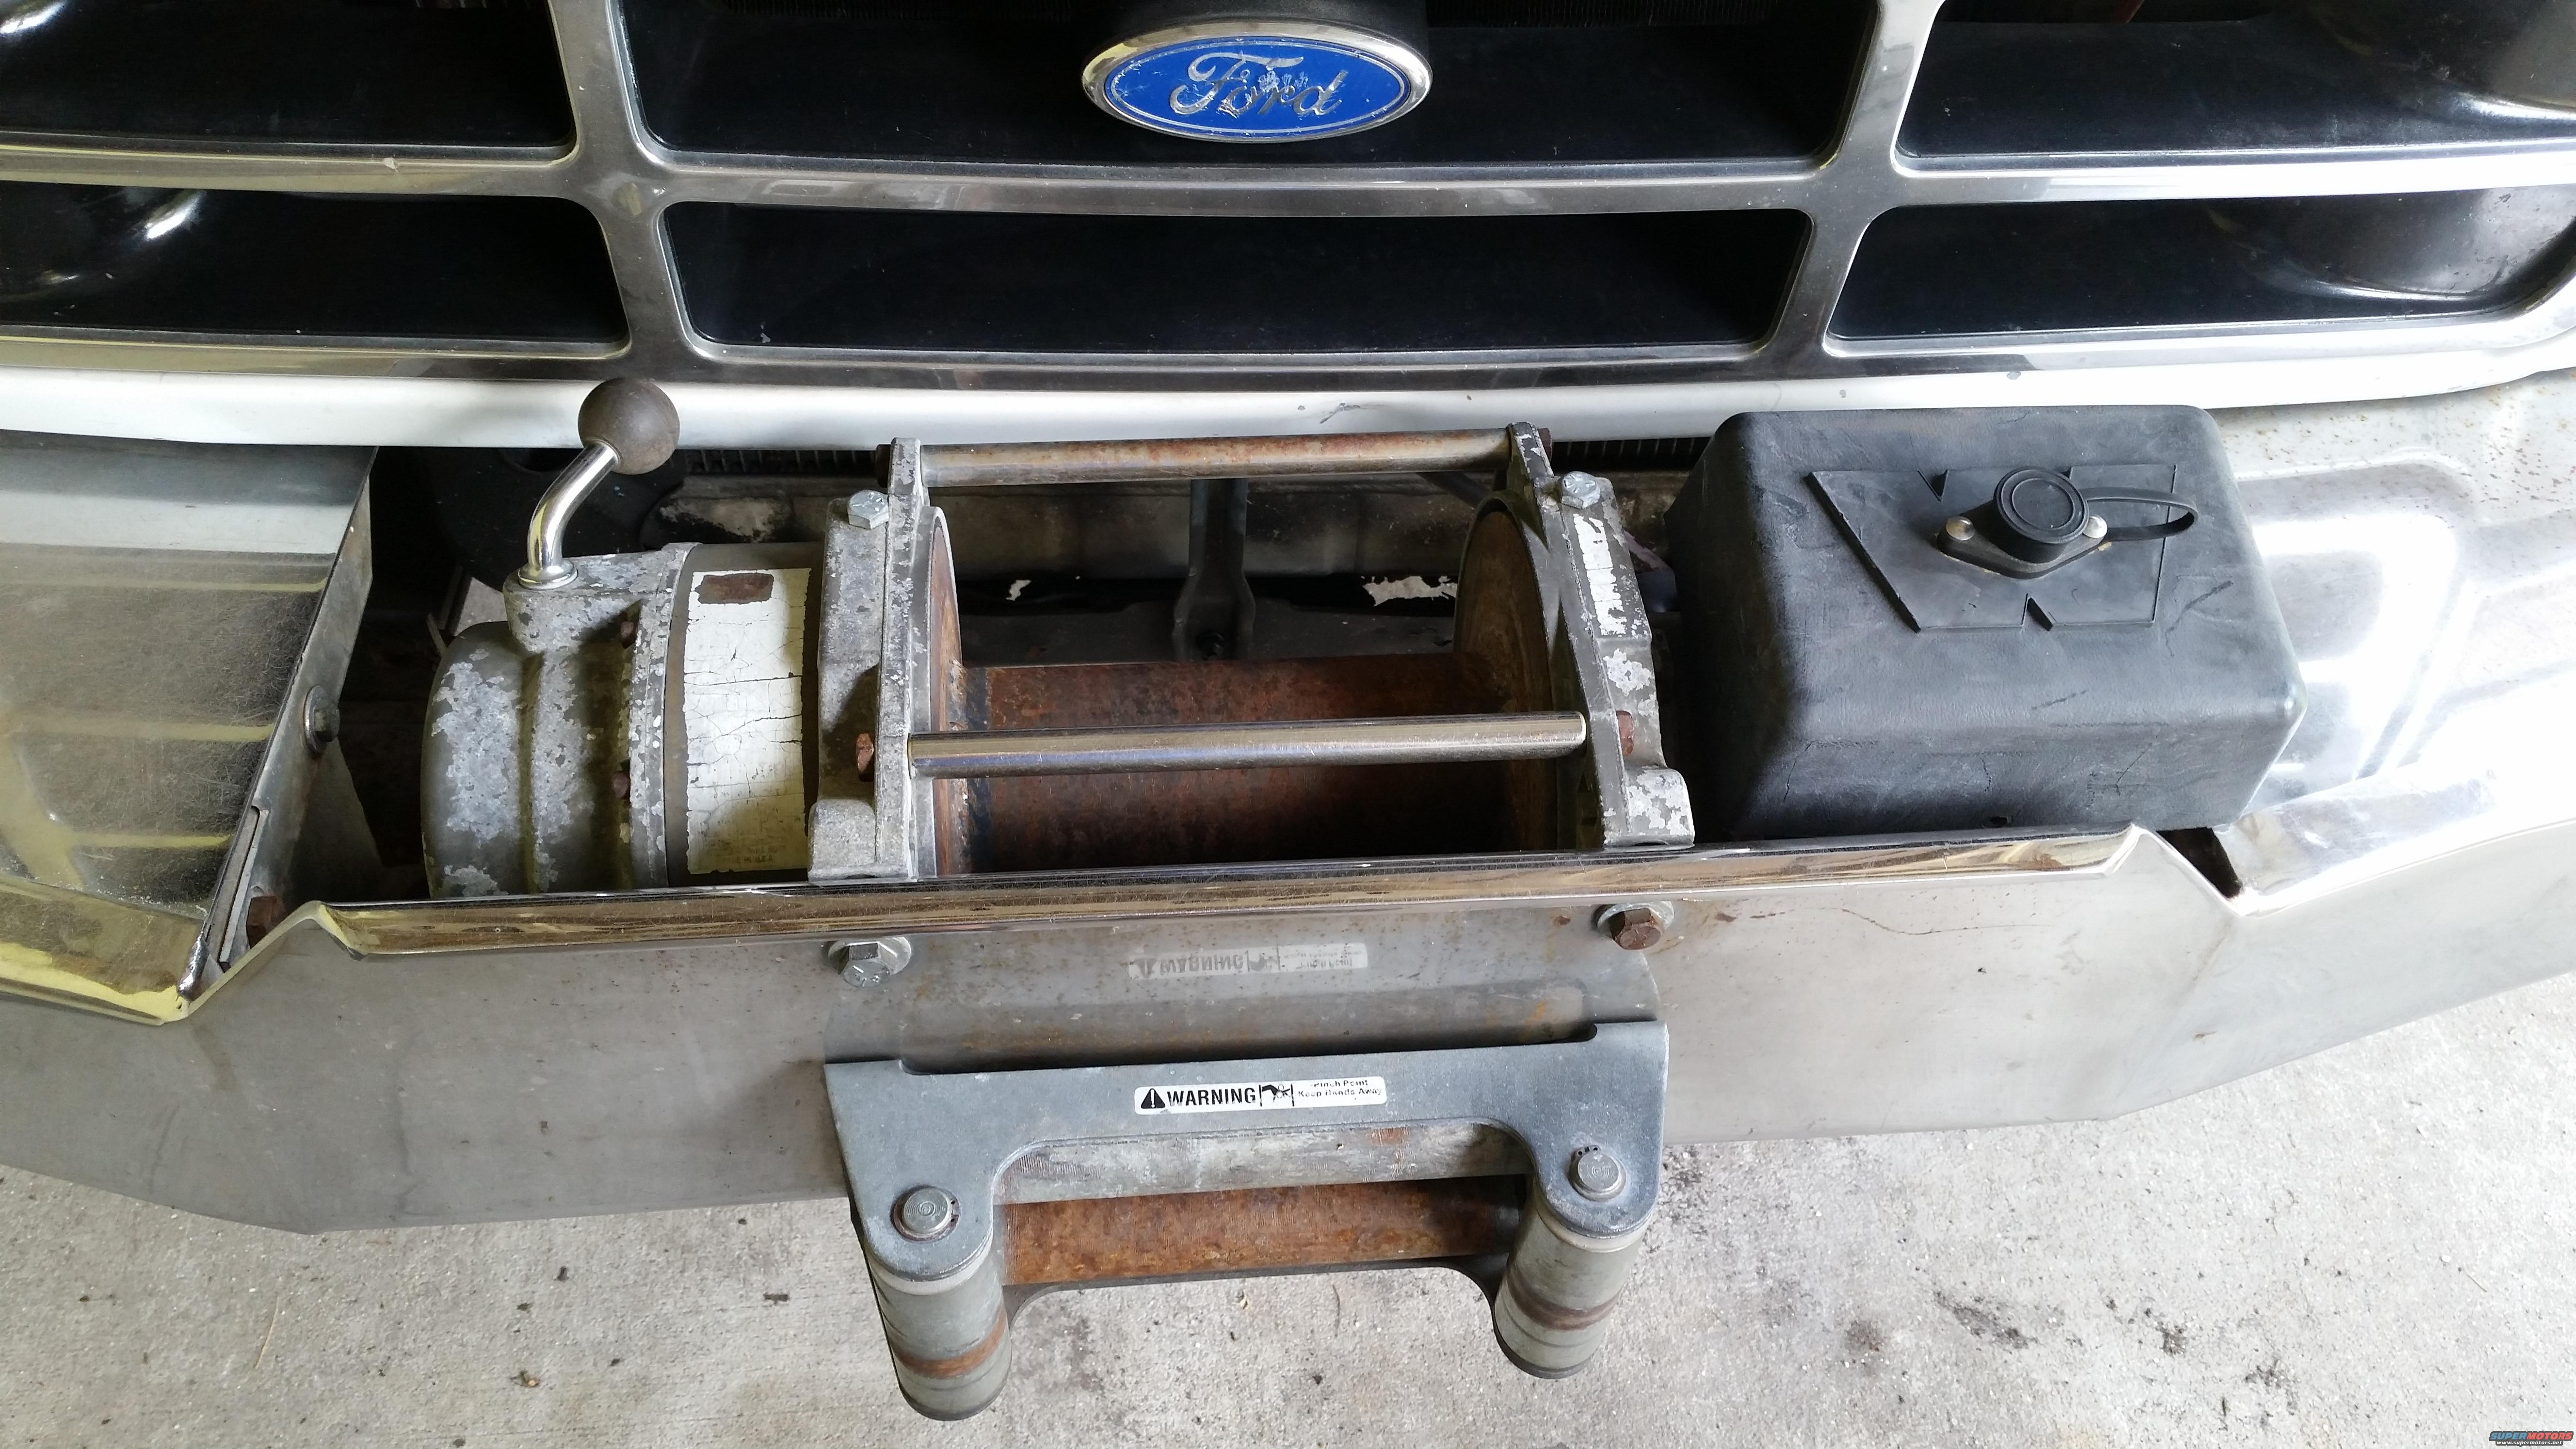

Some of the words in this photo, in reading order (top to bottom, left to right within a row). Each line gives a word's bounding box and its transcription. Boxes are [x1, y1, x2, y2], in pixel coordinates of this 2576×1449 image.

[1169, 52, 1348, 117] Ford
[1167, 1088, 1256, 1107] WARNING
[1358, 1088, 1382, 1096] Away
